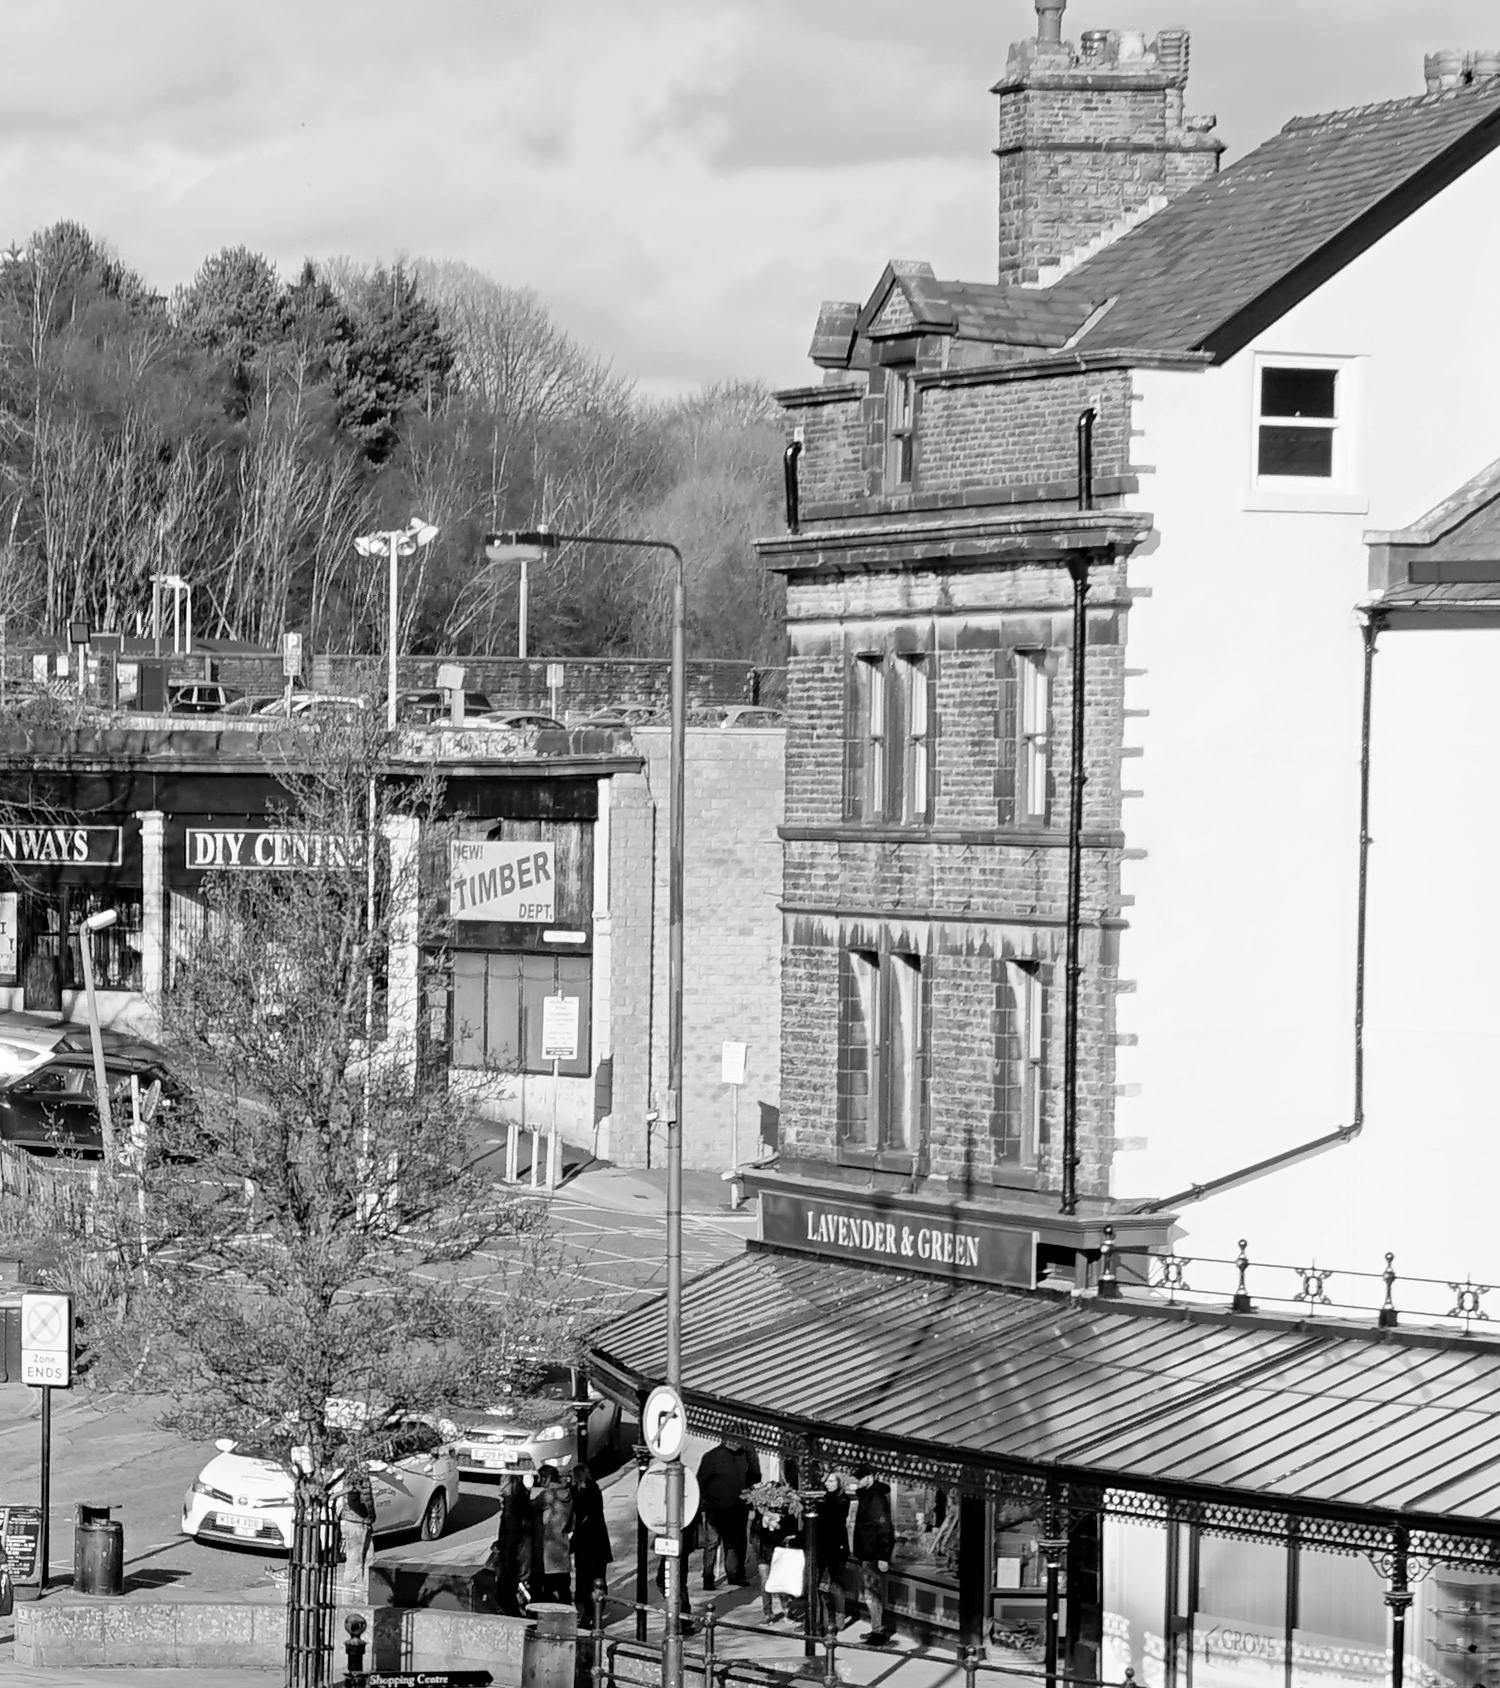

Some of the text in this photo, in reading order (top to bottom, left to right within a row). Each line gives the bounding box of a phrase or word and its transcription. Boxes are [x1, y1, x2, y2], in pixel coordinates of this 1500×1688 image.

[195, 833, 246, 865] DIY
[452, 844, 484, 860] NEW!
[453, 851, 552, 911] TIMBER
[518, 903, 553, 920] DEPT.
[807, 1211, 980, 1267] LAVENDER & GREEN
[33, 1354, 56, 1363] Zone
[27, 1366, 63, 1379] ENDS
[369, 1674, 449, 1688] Shopping Centre
